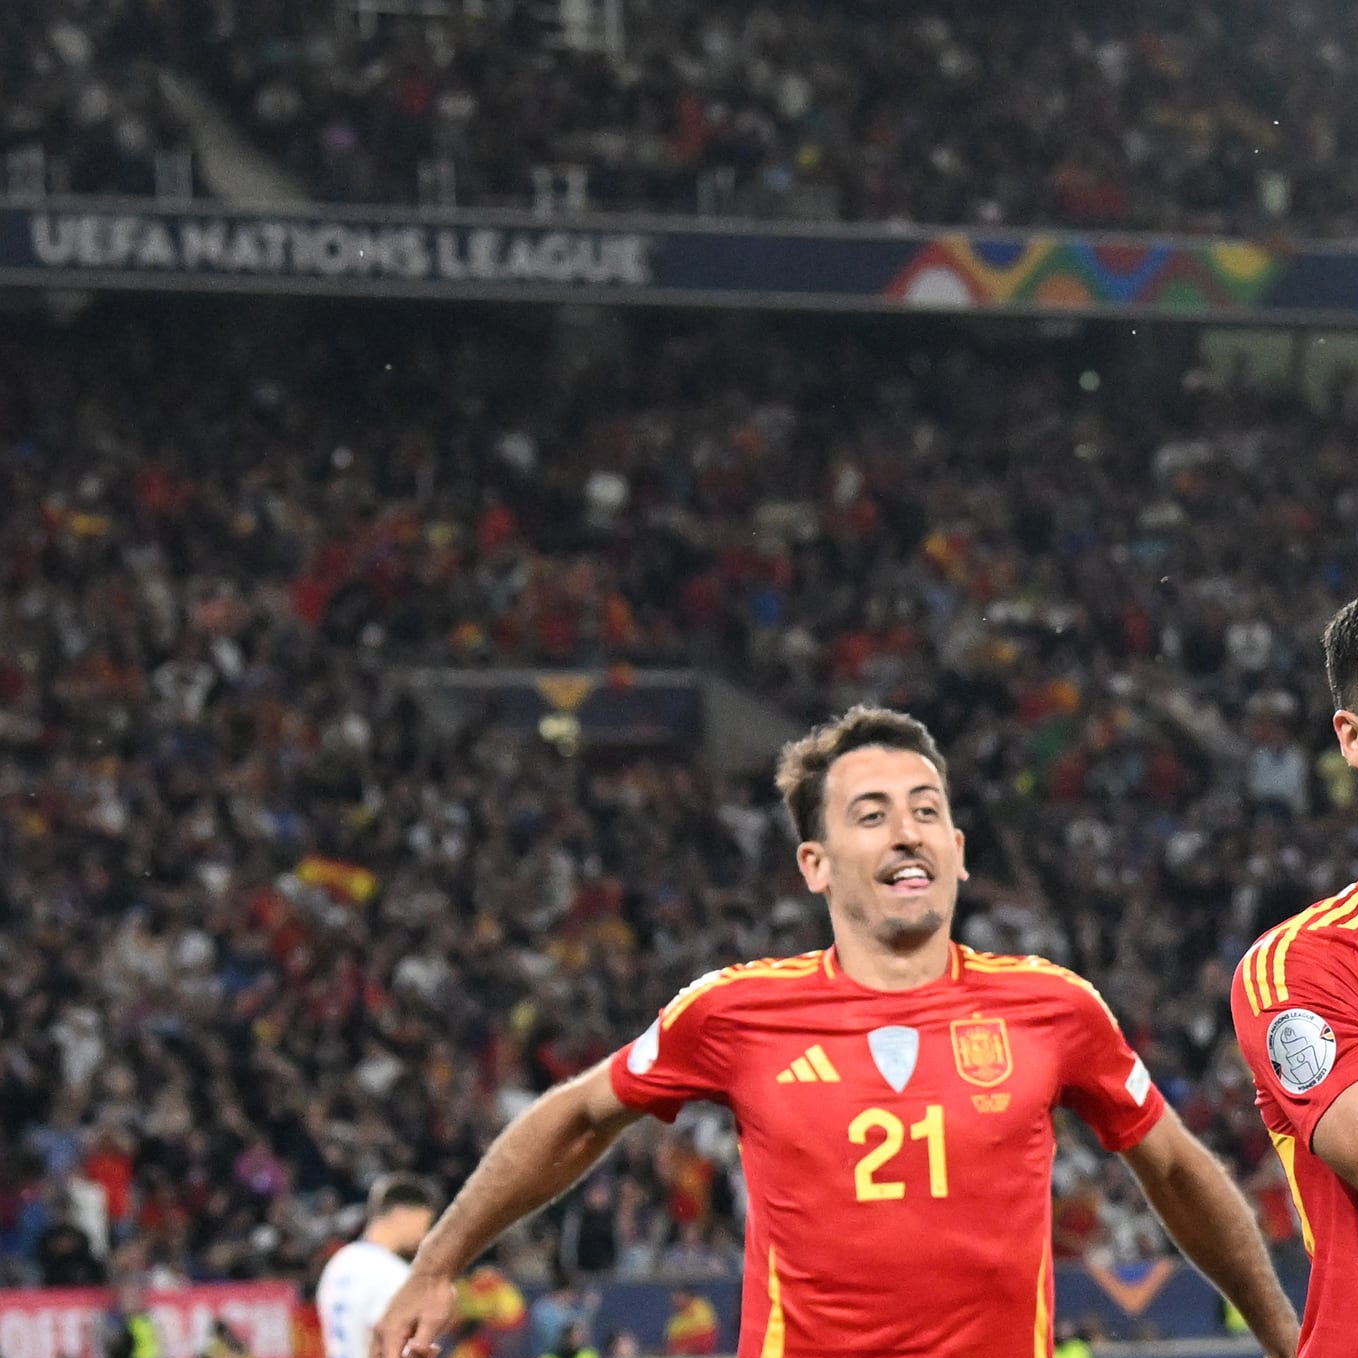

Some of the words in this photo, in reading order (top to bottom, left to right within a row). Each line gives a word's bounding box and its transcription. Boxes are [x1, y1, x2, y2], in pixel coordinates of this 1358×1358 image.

[32, 214, 177, 266] UEFA
[180, 220, 430, 278] NATIONS
[438, 228, 652, 285] LEAGUE
[848, 1105, 948, 1202] 21
